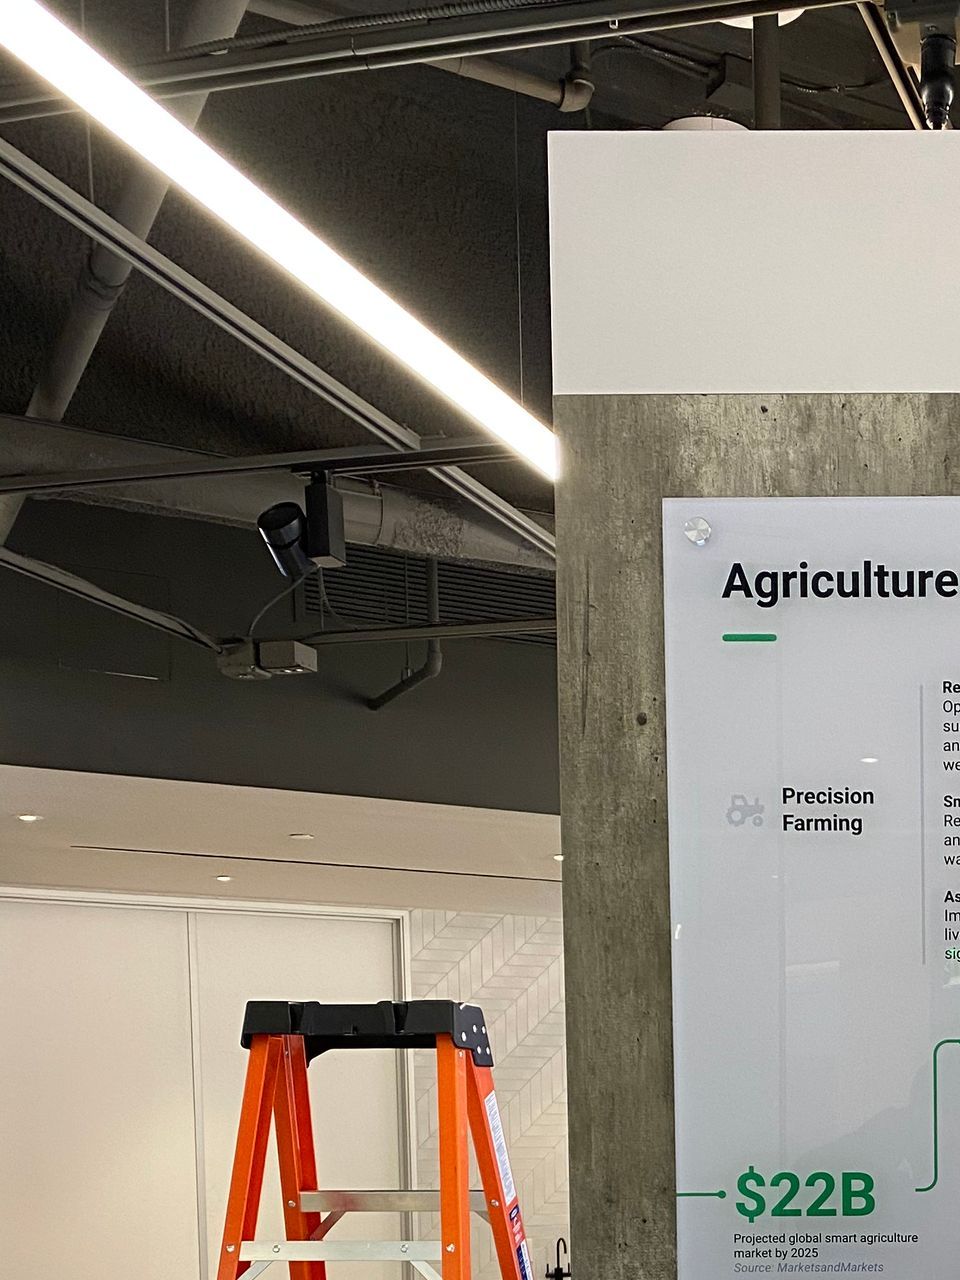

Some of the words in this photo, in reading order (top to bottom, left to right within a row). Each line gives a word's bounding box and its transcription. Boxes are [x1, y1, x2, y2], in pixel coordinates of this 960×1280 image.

[721, 560, 959, 609] Agriculture
[782, 786, 875, 805] Precision
[782, 813, 863, 836] Farming
[735, 1165, 876, 1224] $22B
[733, 1232, 786, 1247] Projected
[788, 1232, 822, 1246] global
[824, 1233, 858, 1244] smart
[859, 1232, 919, 1246] agriculture
[733, 1247, 773, 1259] market
[775, 1247, 789, 1261] by
[790, 1247, 819, 1258] 2025
[733, 1262, 775, 1273] Source:
[776, 1261, 884, 1273] MarketsandMarkets
